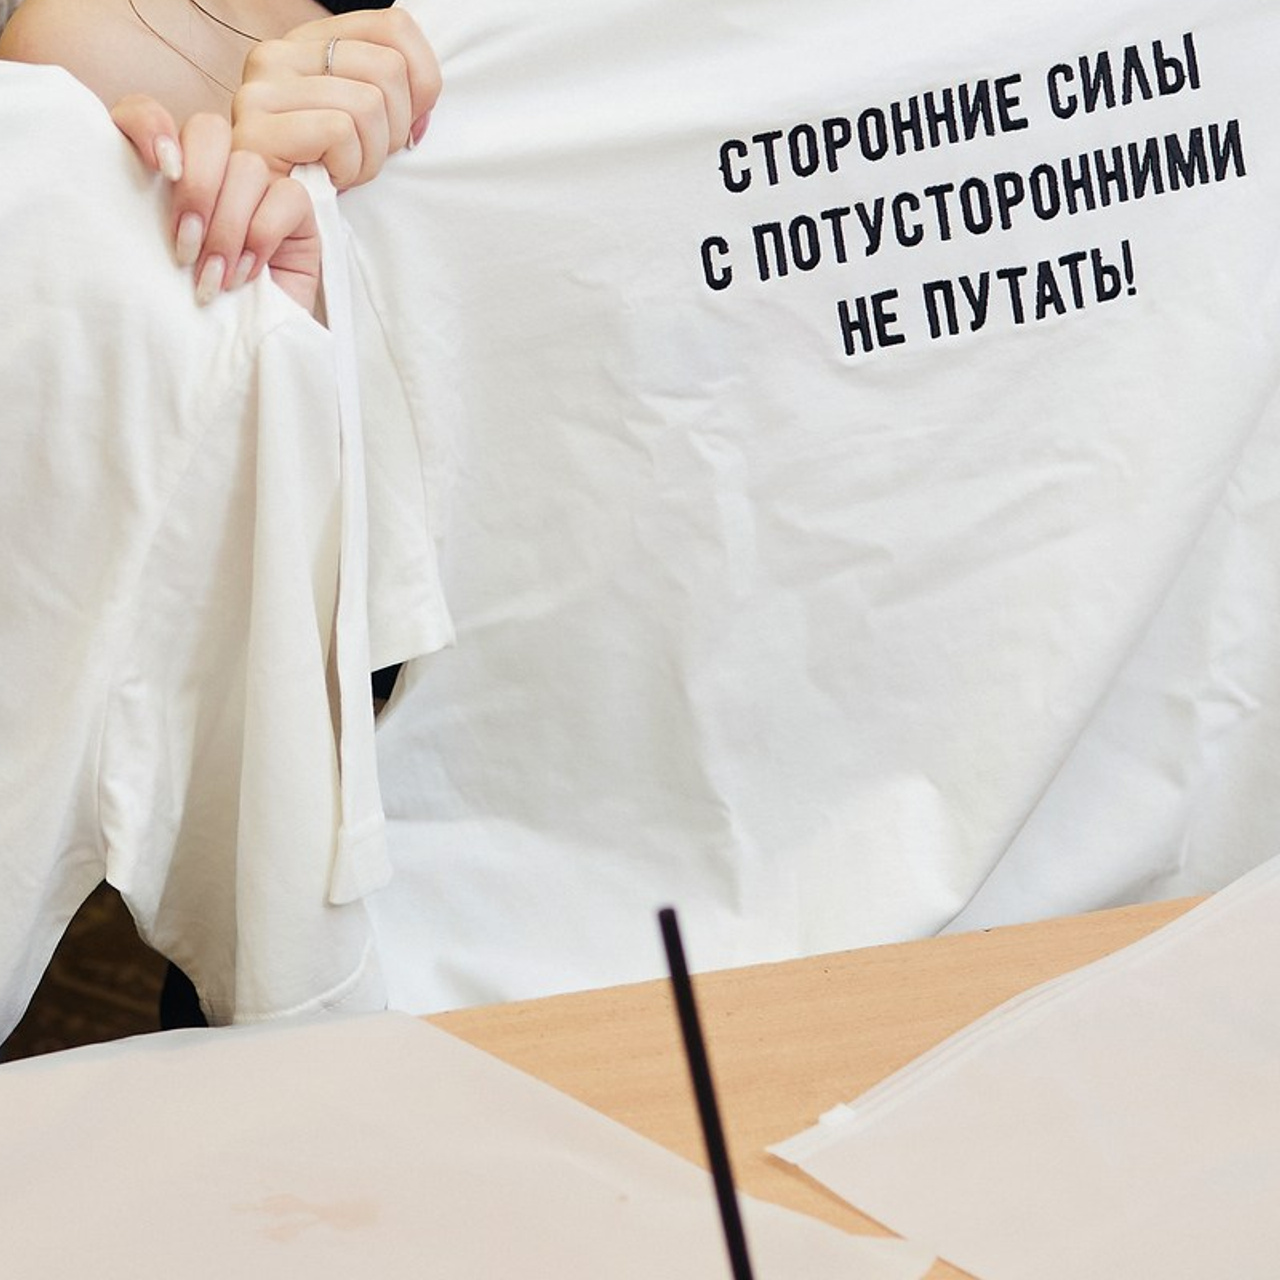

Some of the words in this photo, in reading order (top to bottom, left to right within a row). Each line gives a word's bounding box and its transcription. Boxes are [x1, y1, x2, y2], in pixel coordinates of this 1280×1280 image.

[718, 73, 1029, 193] СТОРОННИЕ
[1047, 32, 1201, 120] СИЛЫ
[700, 236, 733, 291] С
[752, 118, 1247, 282] ПОТУСТОРОННИМИ
[837, 288, 906, 356] НЕ
[922, 239, 1138, 339] ПУТАТЬ!
